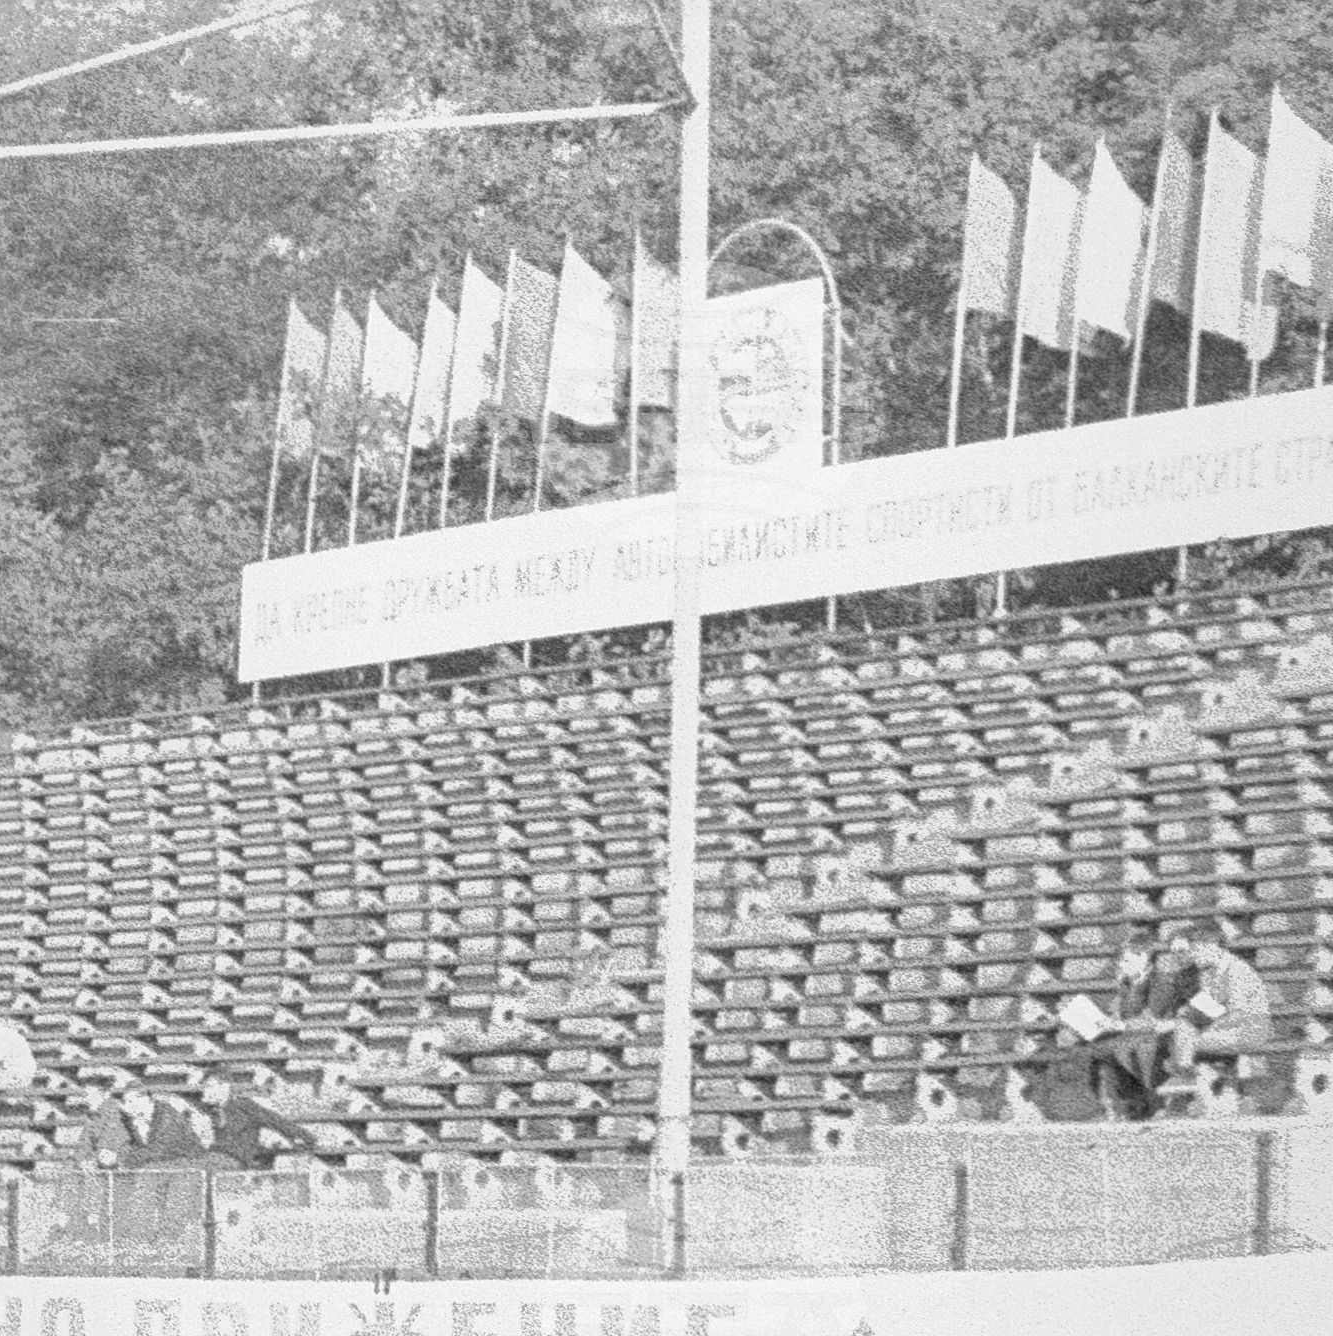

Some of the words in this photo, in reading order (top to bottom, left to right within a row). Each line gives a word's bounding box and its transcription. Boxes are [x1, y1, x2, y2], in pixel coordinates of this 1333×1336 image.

[382, 563, 501, 622] ДРУЖБАТА
[513, 546, 597, 599] МЕЖДУ
[612, 508, 850, 582] АВТОБИЛИСТИТЕ
[1071, 441, 1265, 515] БАЛКАНСКИТЕ
